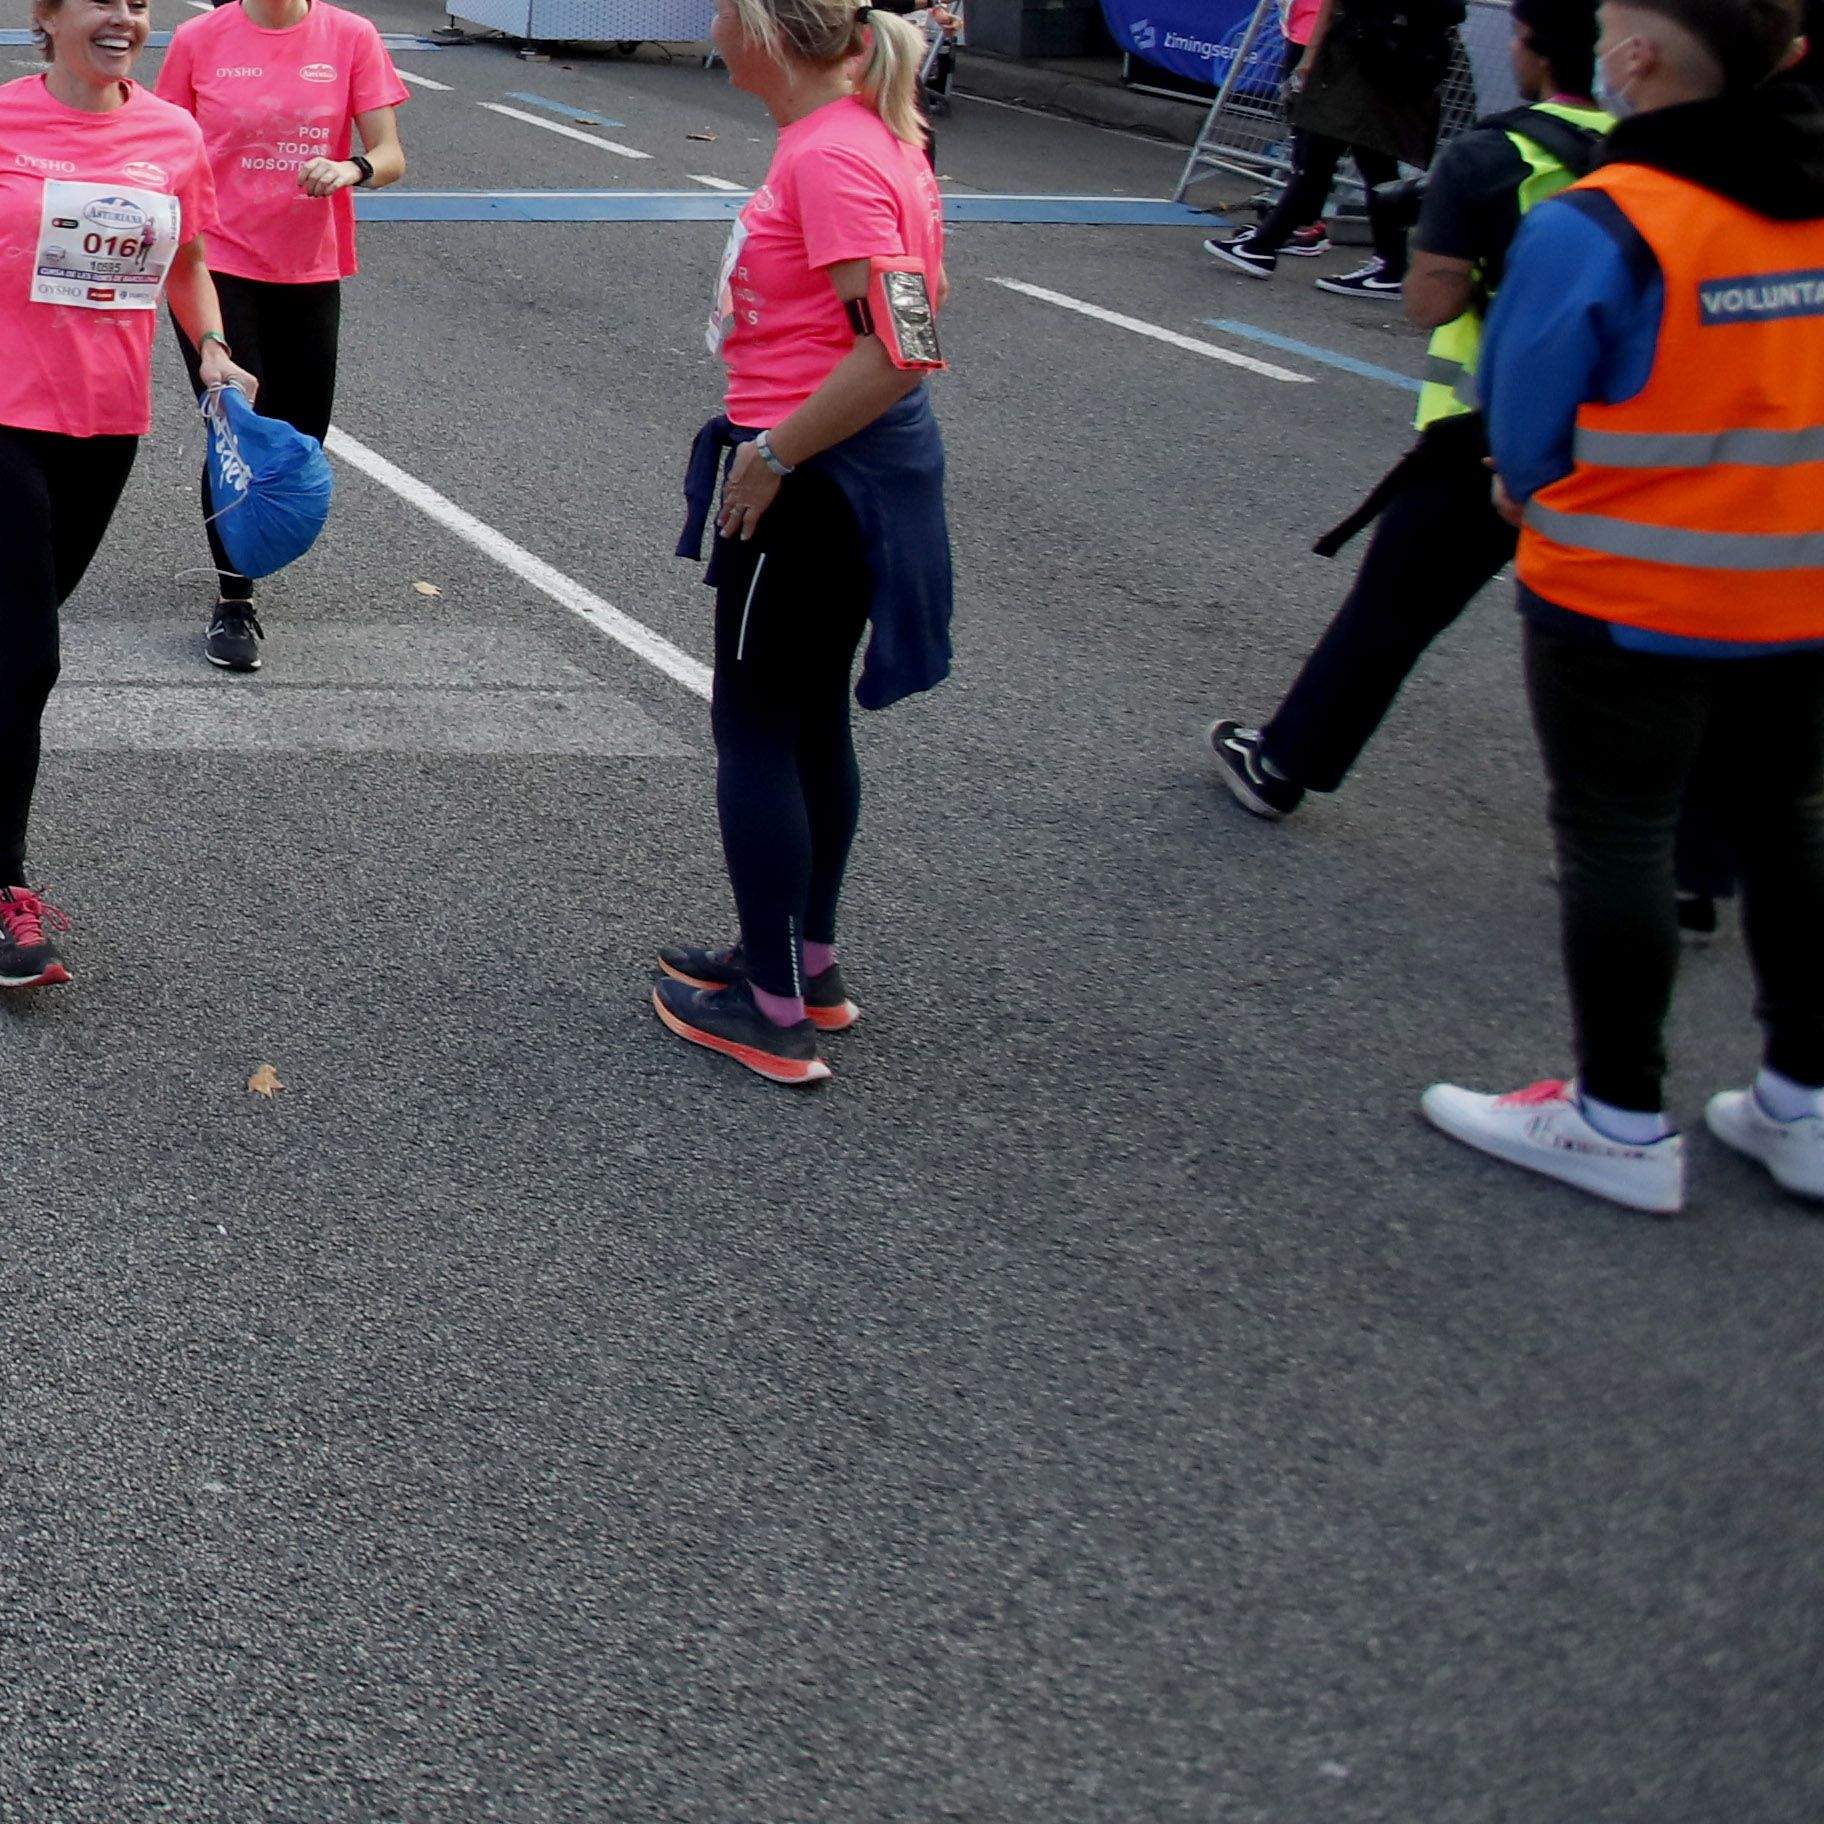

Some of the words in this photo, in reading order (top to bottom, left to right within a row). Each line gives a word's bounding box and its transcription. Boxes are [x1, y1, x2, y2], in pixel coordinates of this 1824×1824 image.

[1164, 32, 1258, 64] timingsee
[216, 67, 263, 78] OYSHO
[298, 127, 330, 139] POR
[277, 141, 329, 156] TODAS
[15, 155, 76, 174] OYSHO
[241, 158, 304, 172] NOSOT
[83, 233, 138, 258] 016
